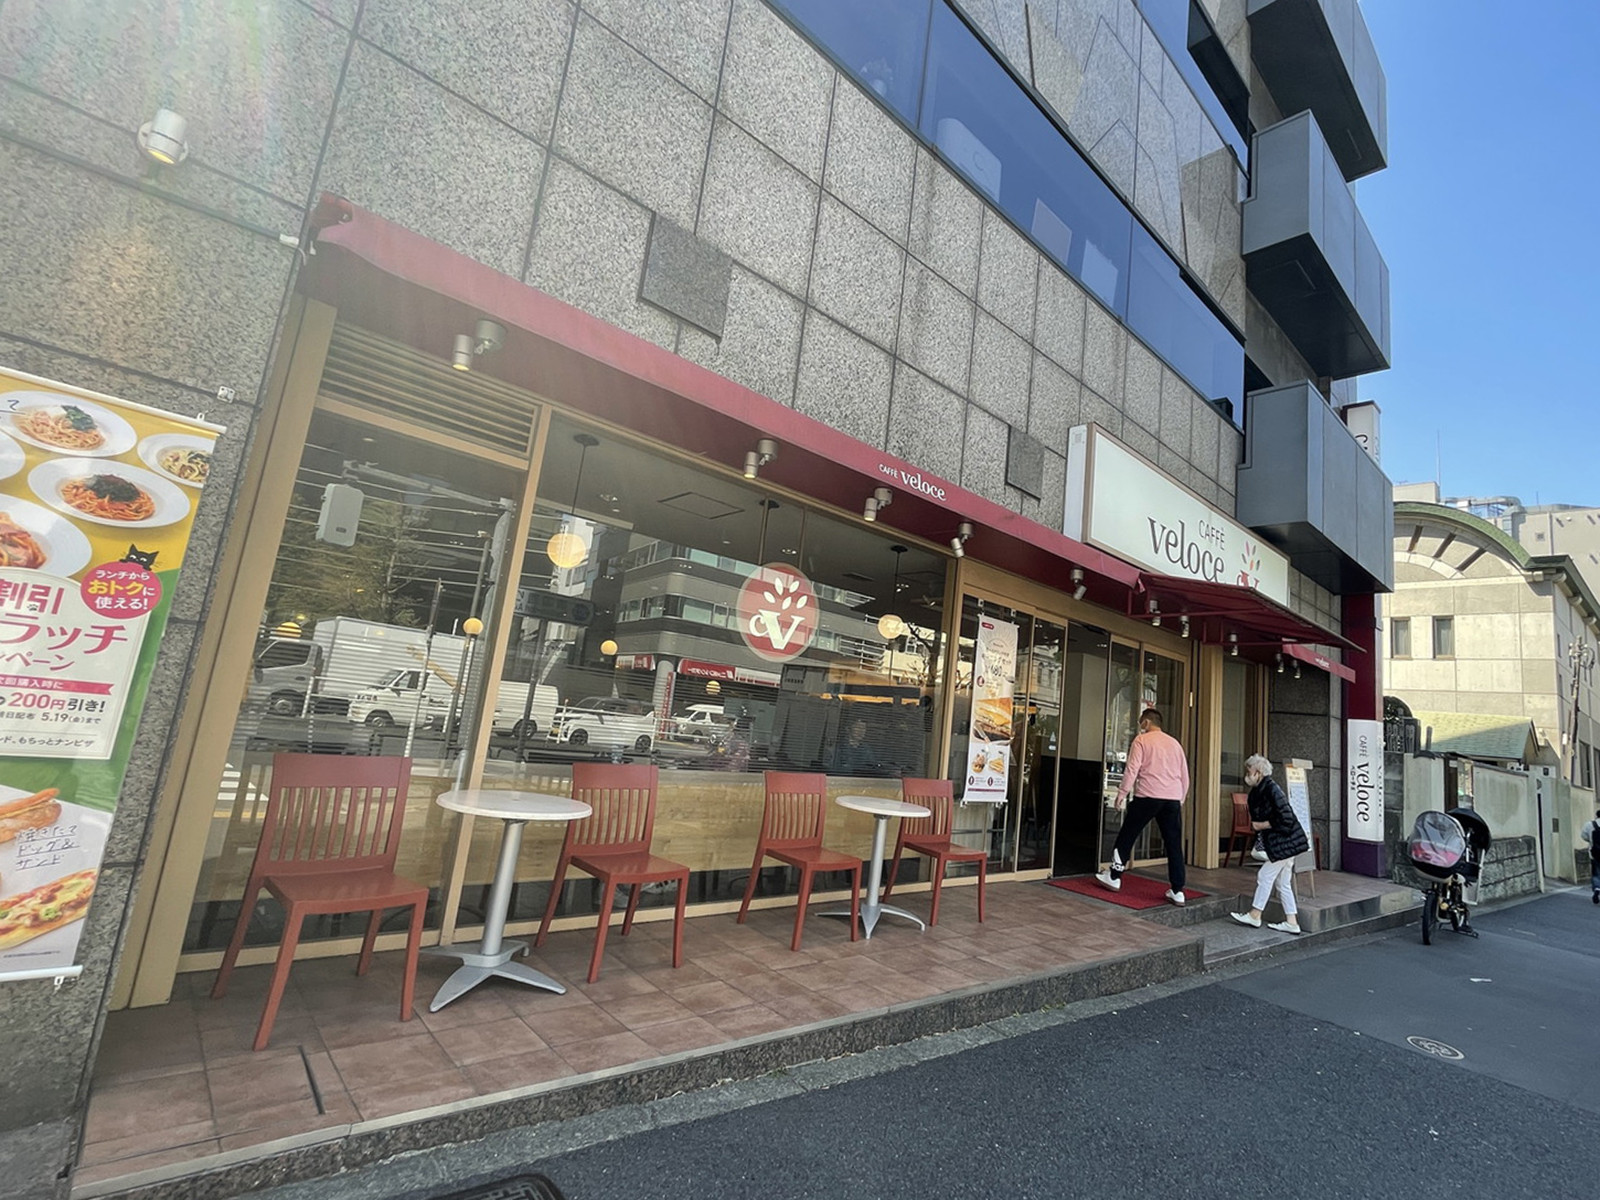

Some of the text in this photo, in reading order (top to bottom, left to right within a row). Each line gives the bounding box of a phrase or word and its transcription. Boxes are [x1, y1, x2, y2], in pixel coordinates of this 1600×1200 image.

[900, 470, 947, 502] veloce
[1147, 516, 1225, 584] veloce
[95, 569, 150, 581] ランチから
[87, 579, 156, 596] おトクに
[94, 596, 148, 610] 使える!
[0, 651, 76, 671] ペーン
[1356, 762, 1375, 822] veloce
